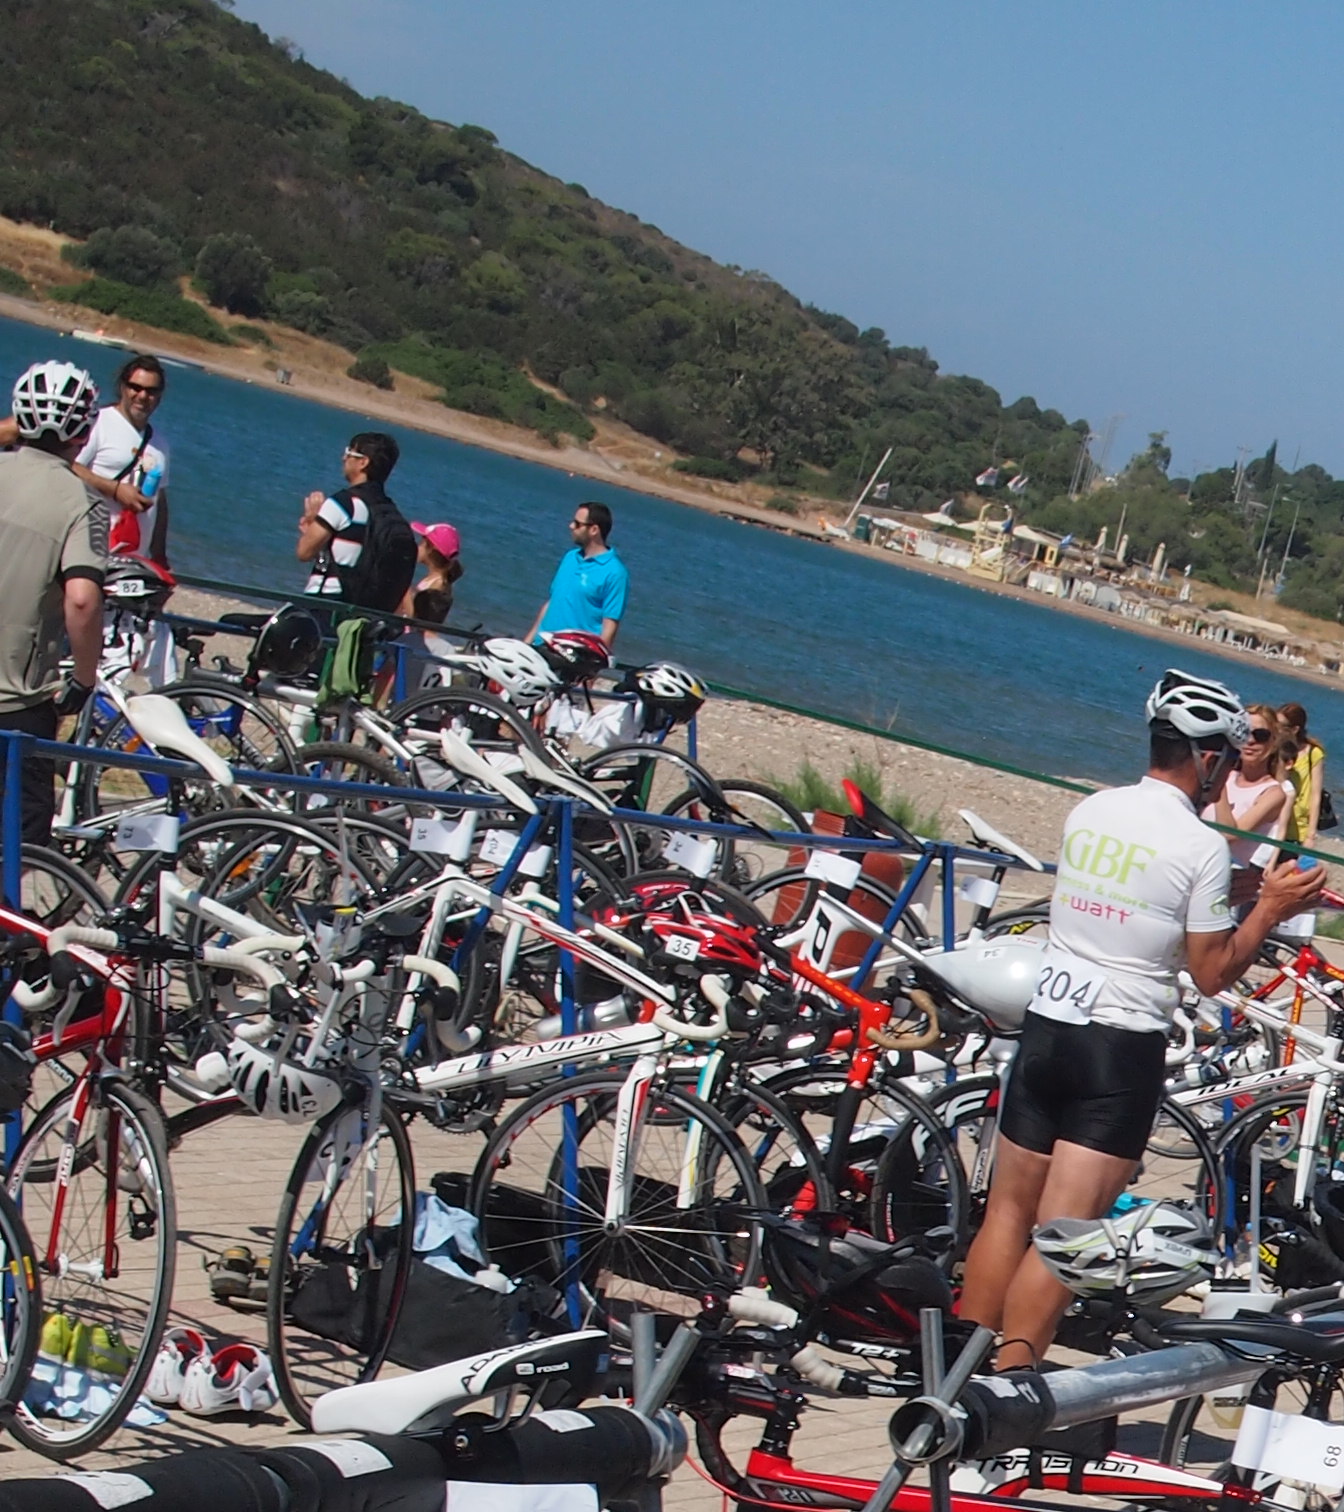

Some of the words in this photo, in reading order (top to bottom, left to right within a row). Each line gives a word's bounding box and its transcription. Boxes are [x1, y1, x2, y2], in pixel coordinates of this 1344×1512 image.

[122, 582, 139, 593] 82
[1064, 828, 1157, 885] GBF
[672, 938, 692, 956] 35
[1037, 966, 1092, 1010] 204
[1197, 1069, 1290, 1095] IDEAL
[1322, 1444, 1343, 1468] 68
